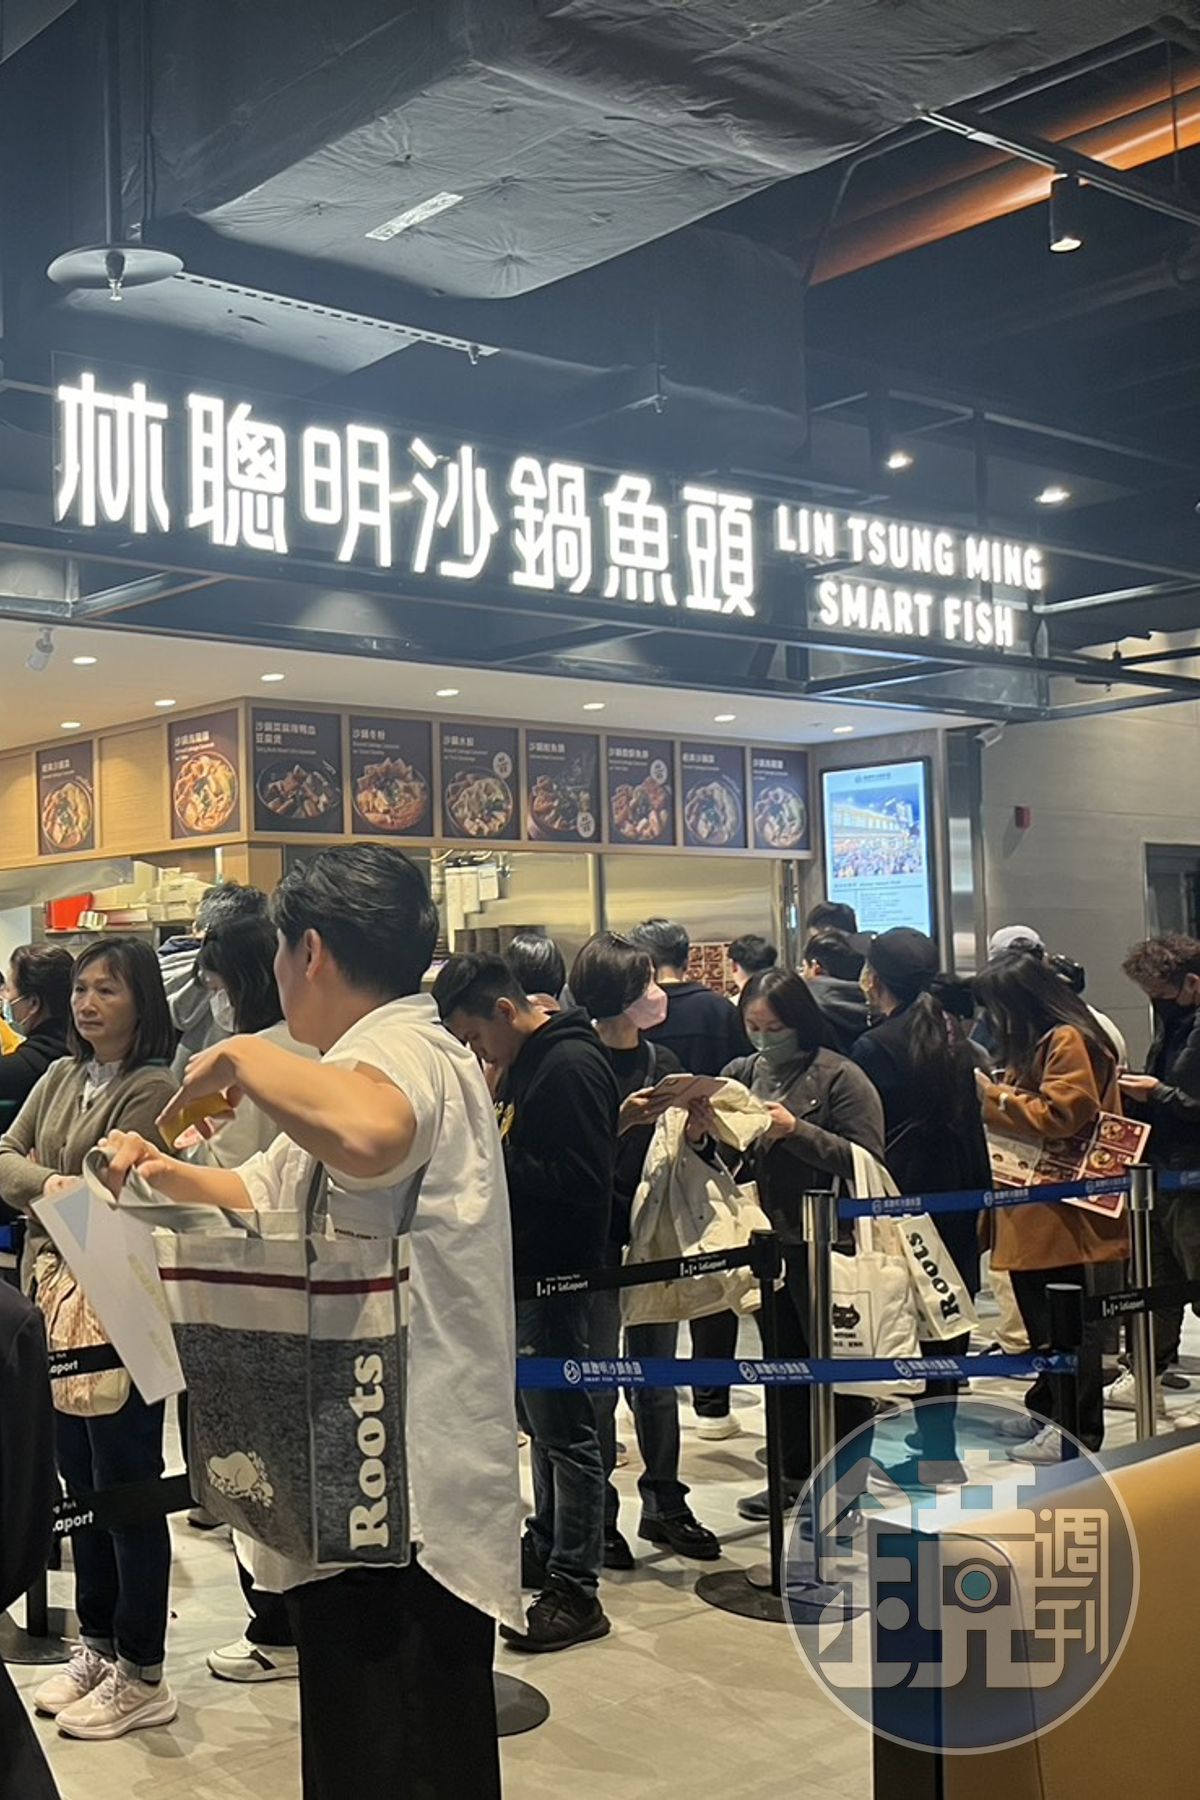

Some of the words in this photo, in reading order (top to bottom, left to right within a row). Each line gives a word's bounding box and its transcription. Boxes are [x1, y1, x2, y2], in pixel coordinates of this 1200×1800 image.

[55, 372, 757, 617] 林聰明沙鍋魚頭
[777, 503, 835, 558] LIN
[848, 517, 955, 576] TSUNG
[964, 536, 1043, 590] MING
[818, 581, 933, 637] SMART
[943, 597, 1014, 647] FISH
[48, 1359, 79, 1376] aport
[347, 1353, 390, 1551] Roots
[52, 1510, 94, 1533] aport
